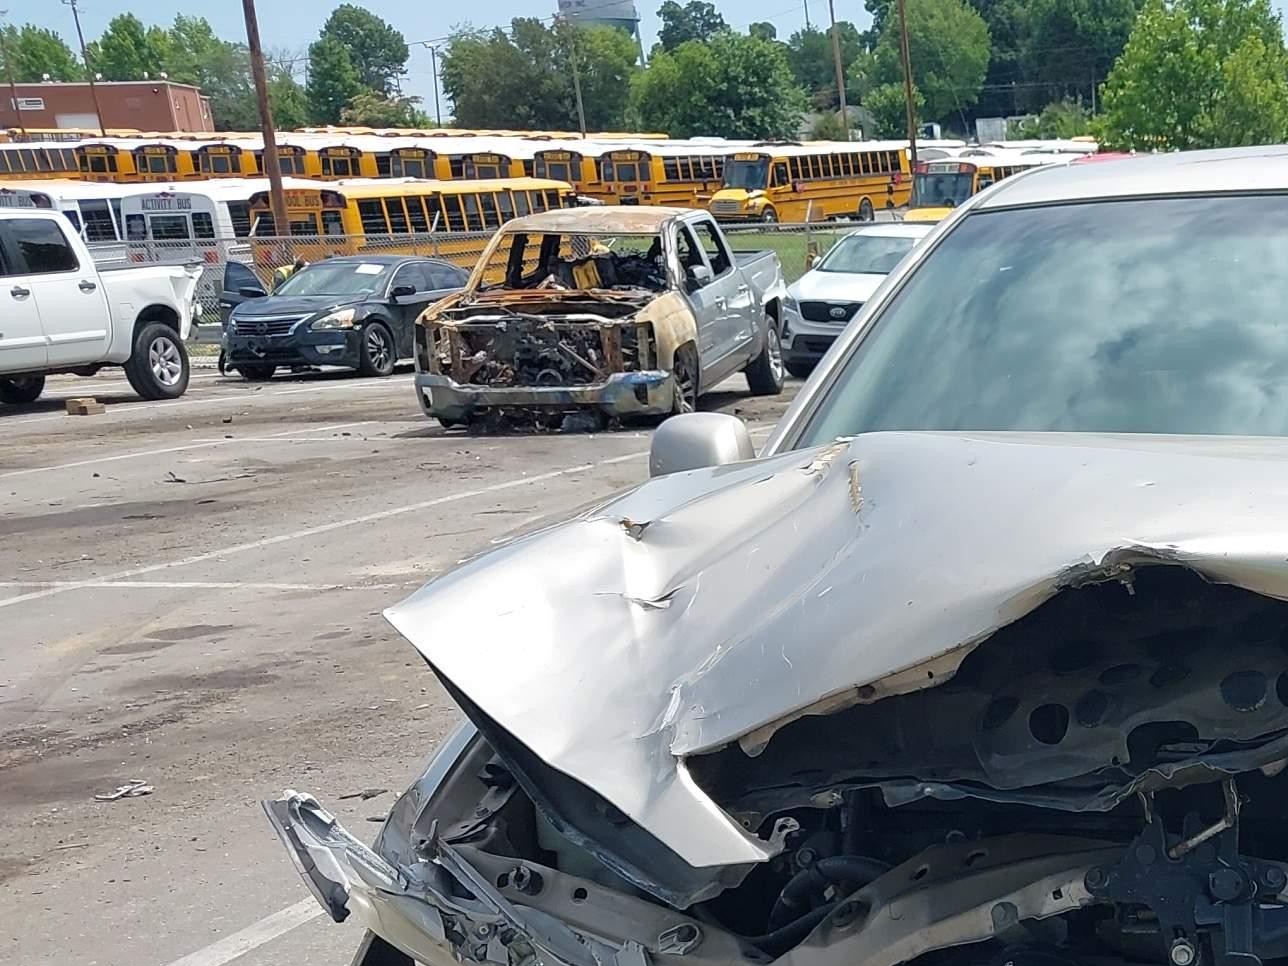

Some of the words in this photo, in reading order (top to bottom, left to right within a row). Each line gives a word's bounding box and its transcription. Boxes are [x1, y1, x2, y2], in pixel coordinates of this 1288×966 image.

[142, 199, 172, 210] ACTIVITY
[177, 198, 192, 210] BUS
[304, 195, 319, 207] BUS
